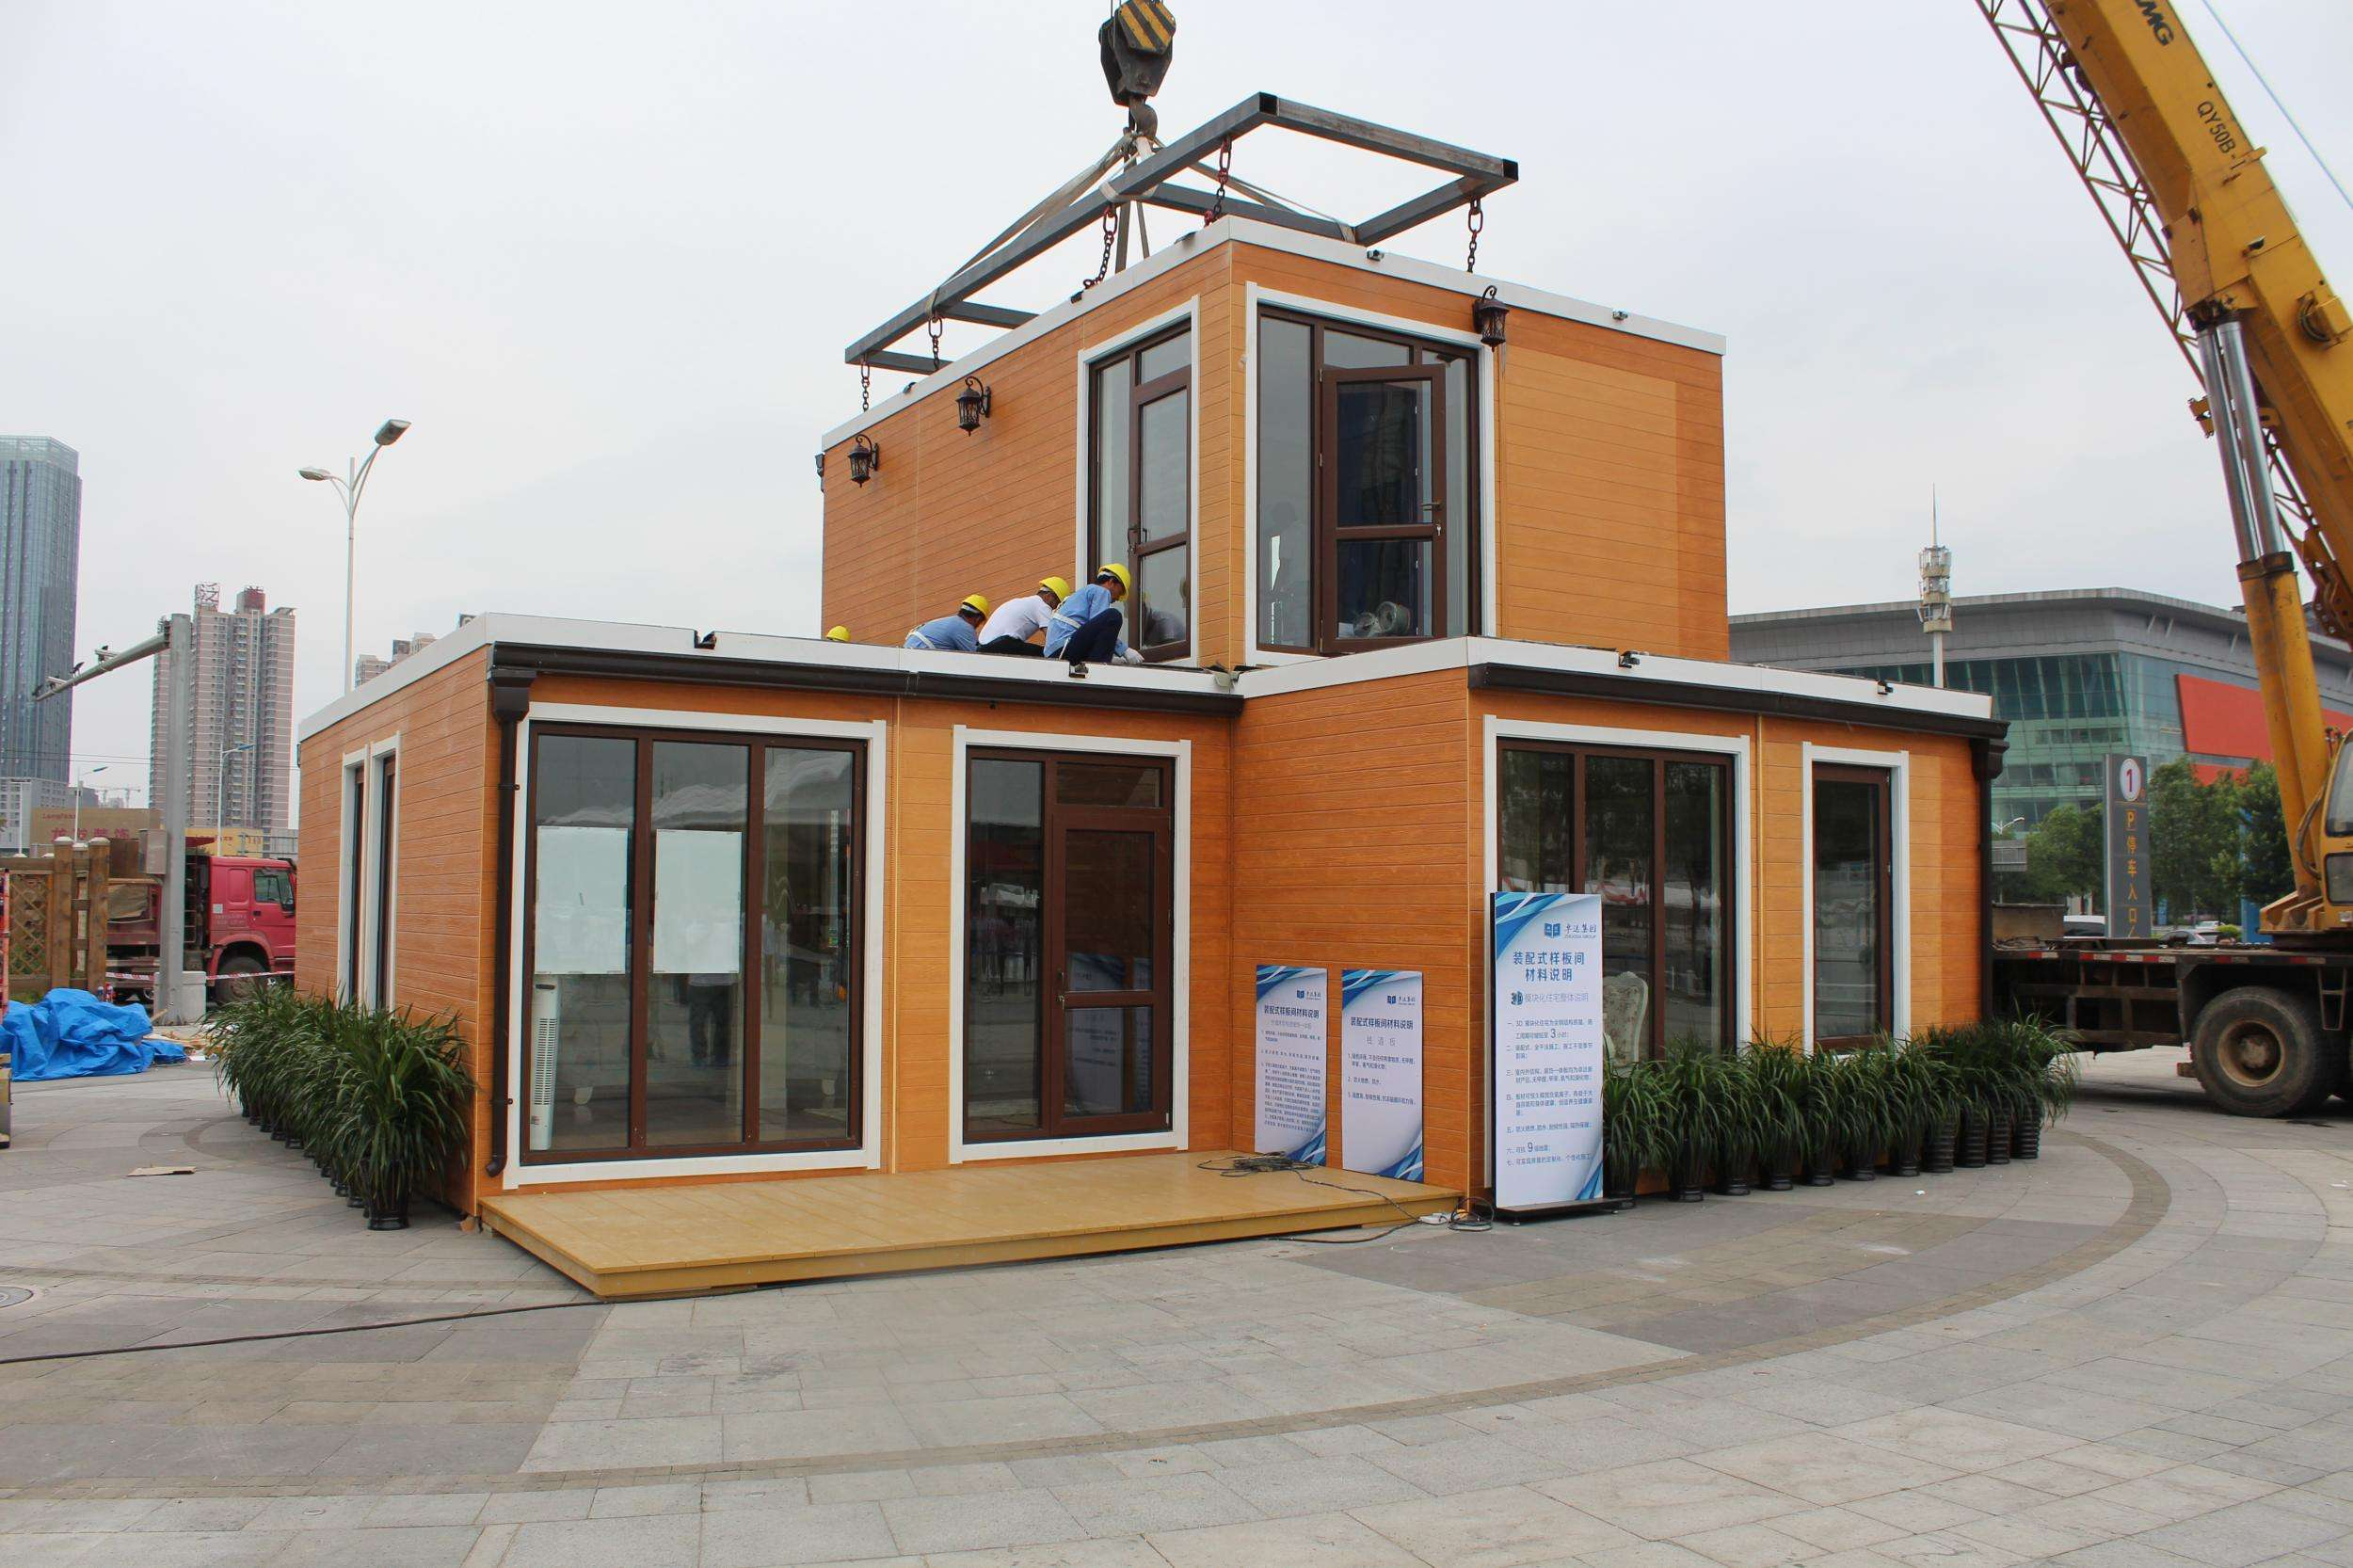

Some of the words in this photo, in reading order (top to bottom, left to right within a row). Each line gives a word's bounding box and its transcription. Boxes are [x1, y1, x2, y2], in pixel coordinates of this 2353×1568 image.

[2134, 0, 2174, 46] MG
[2126, 768, 2133, 792] 1
[2126, 835, 2137, 924] 停车入口
[1513, 951, 1584, 965] 装配式样板间
[1526, 968, 1572, 981] 材料说明
[1265, 1004, 1320, 1019] 装配式样板间材料说明
[1352, 1016, 1414, 1031] 装配式样板间材料说明
